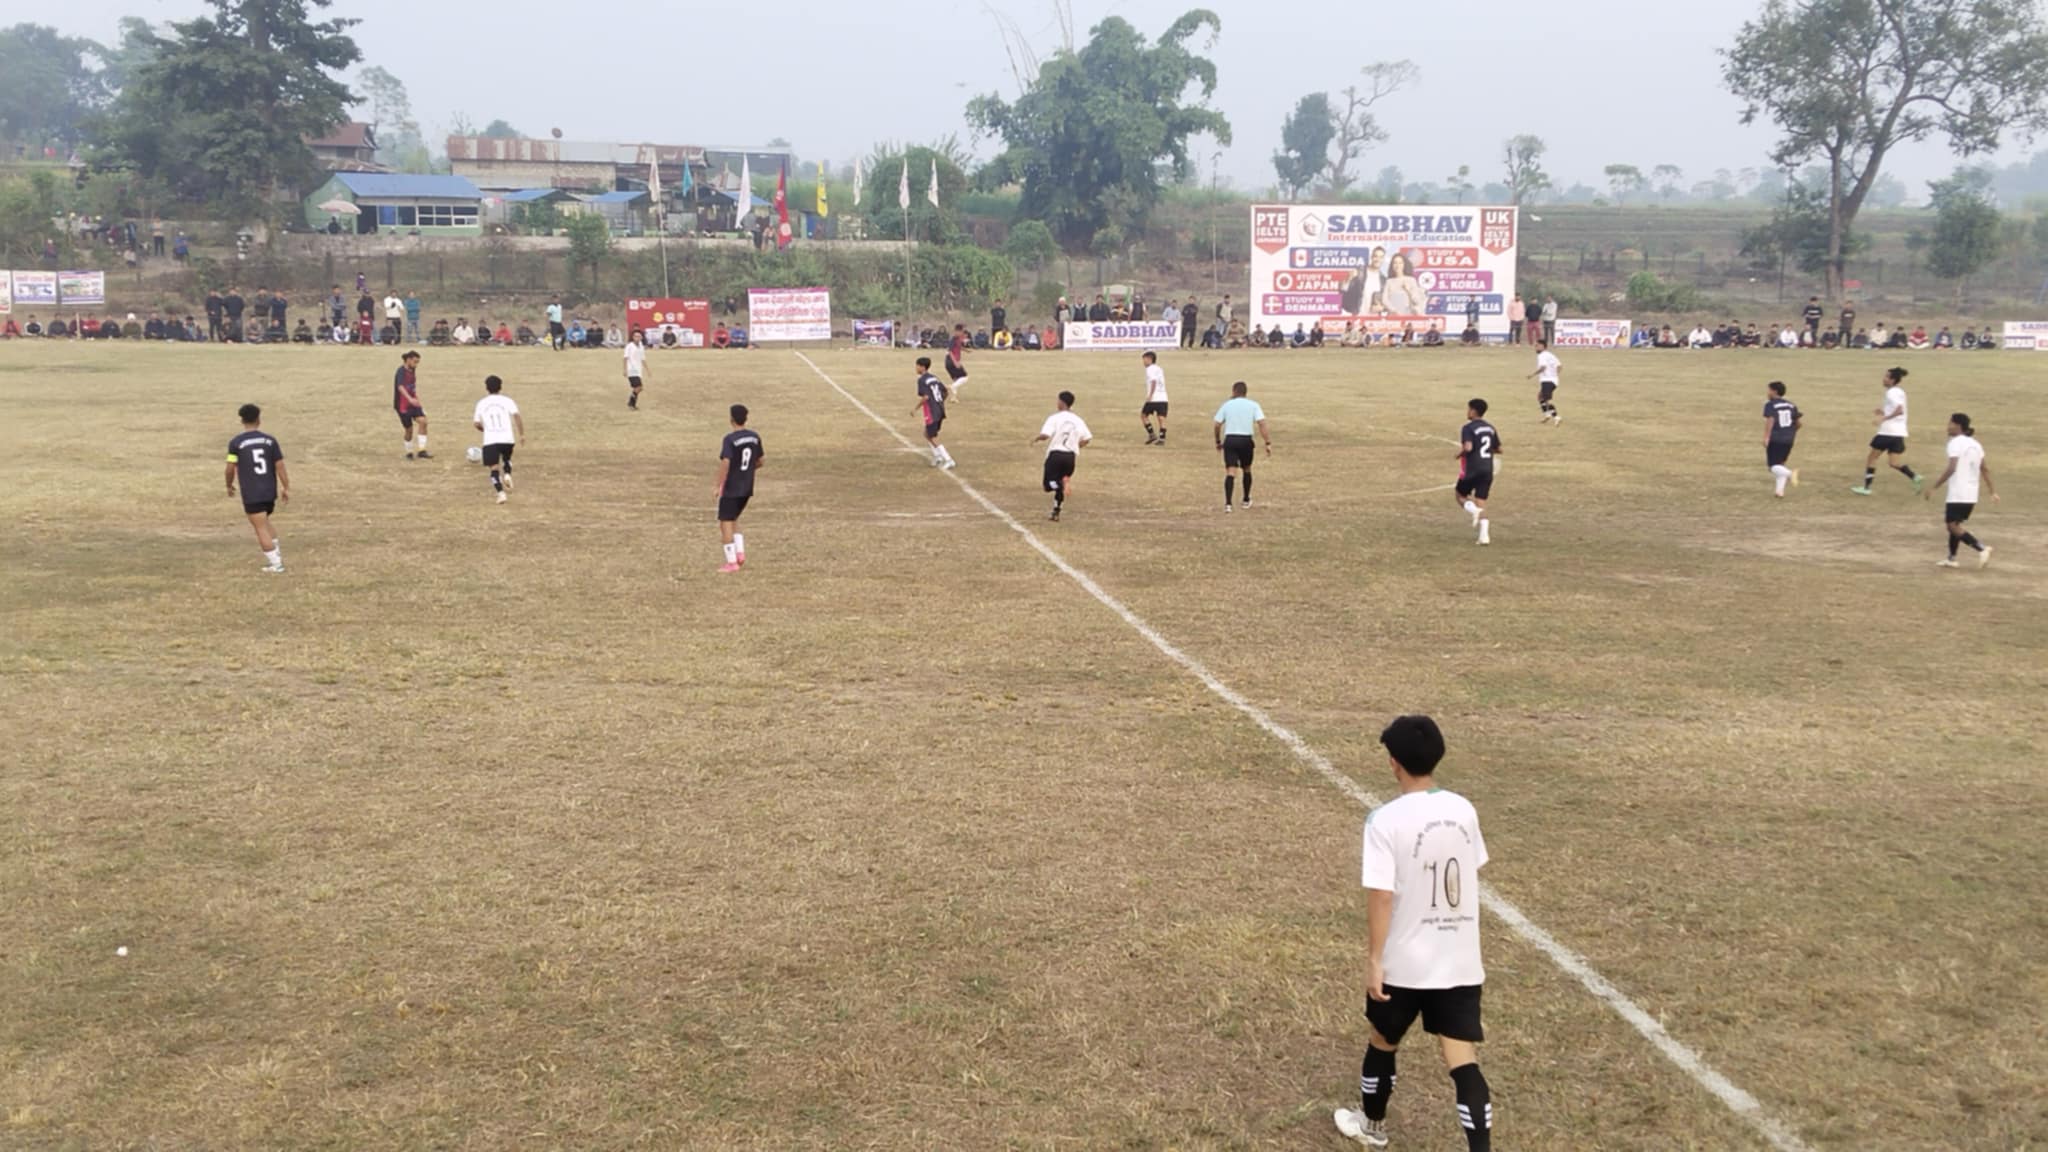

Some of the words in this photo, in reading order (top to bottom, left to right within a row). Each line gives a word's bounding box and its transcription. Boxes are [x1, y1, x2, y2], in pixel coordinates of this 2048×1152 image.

[1256, 213, 1287, 226] PTE
[1485, 211, 1510, 224] UK
[1327, 215, 1473, 233] SADBHAV
[1256, 227, 1287, 236] IELTS
[1328, 233, 1408, 241] International
[1484, 239, 1510, 249] PTE
[1313, 257, 1365, 267] CANADA
[1427, 256, 1474, 266] USA
[1296, 280, 1339, 290] JAPAN
[1438, 280, 1449, 289] S.
[1450, 280, 1486, 289] KOREA
[1284, 303, 1339, 312] DENMARK
[1446, 303, 1500, 312] AUSALIA
[1091, 325, 1177, 338] SADBHAV
[1556, 337, 1612, 345] KOREA
[1480, 436, 1491, 458] 2
[252, 449, 267, 474] 5
[741, 447, 752, 471] 8
[1423, 857, 1461, 908] 10
